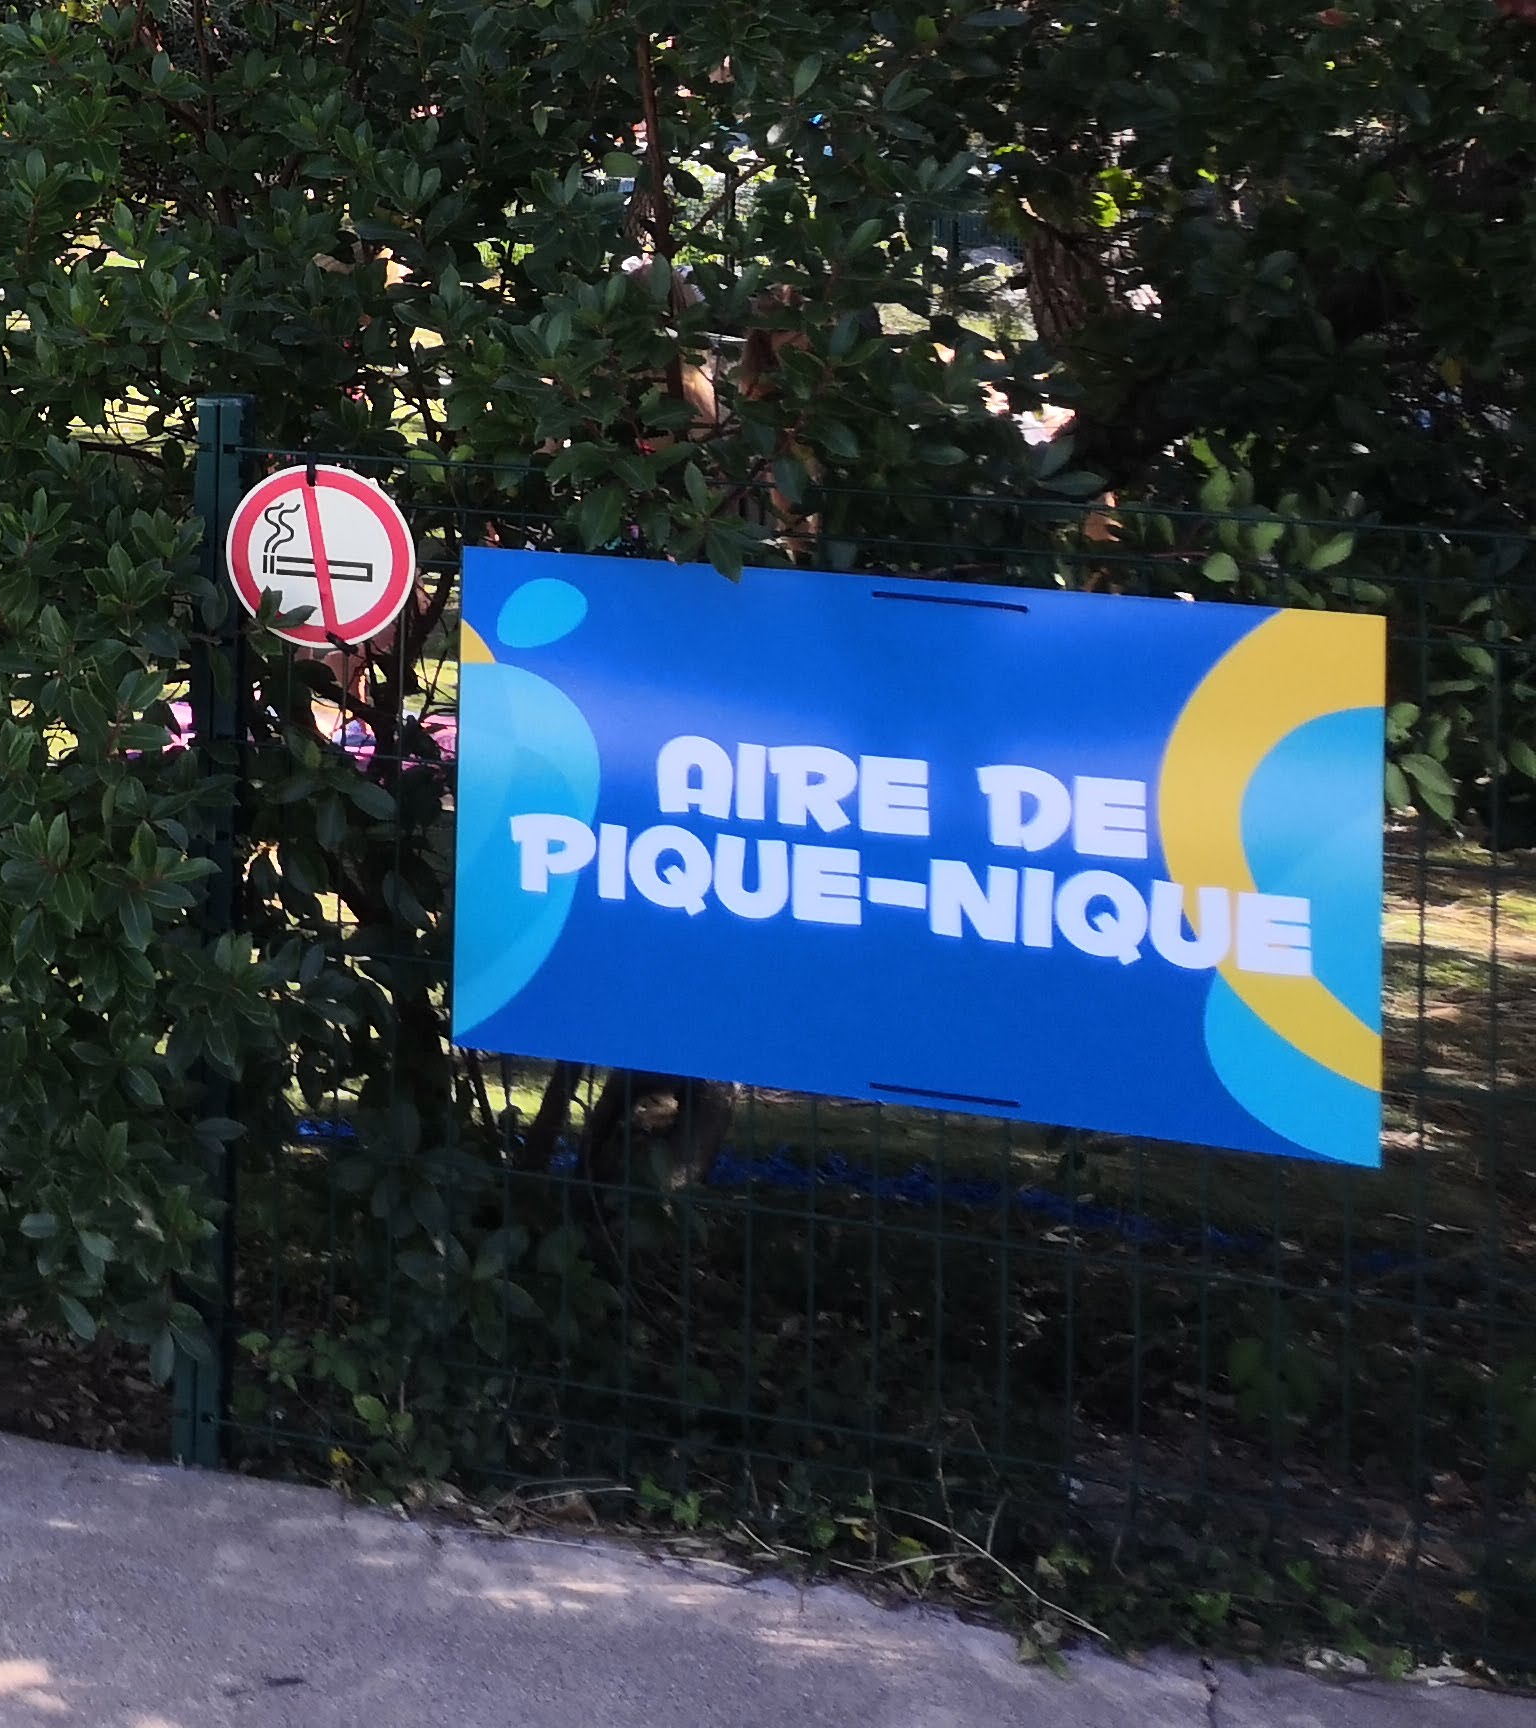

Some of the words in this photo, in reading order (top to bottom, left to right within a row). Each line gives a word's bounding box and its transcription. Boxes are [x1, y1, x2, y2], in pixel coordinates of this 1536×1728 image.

[656, 735, 930, 836] AIRE
[976, 764, 1148, 859] DE
[510, 813, 1313, 976] PIQUE-NIQUE
